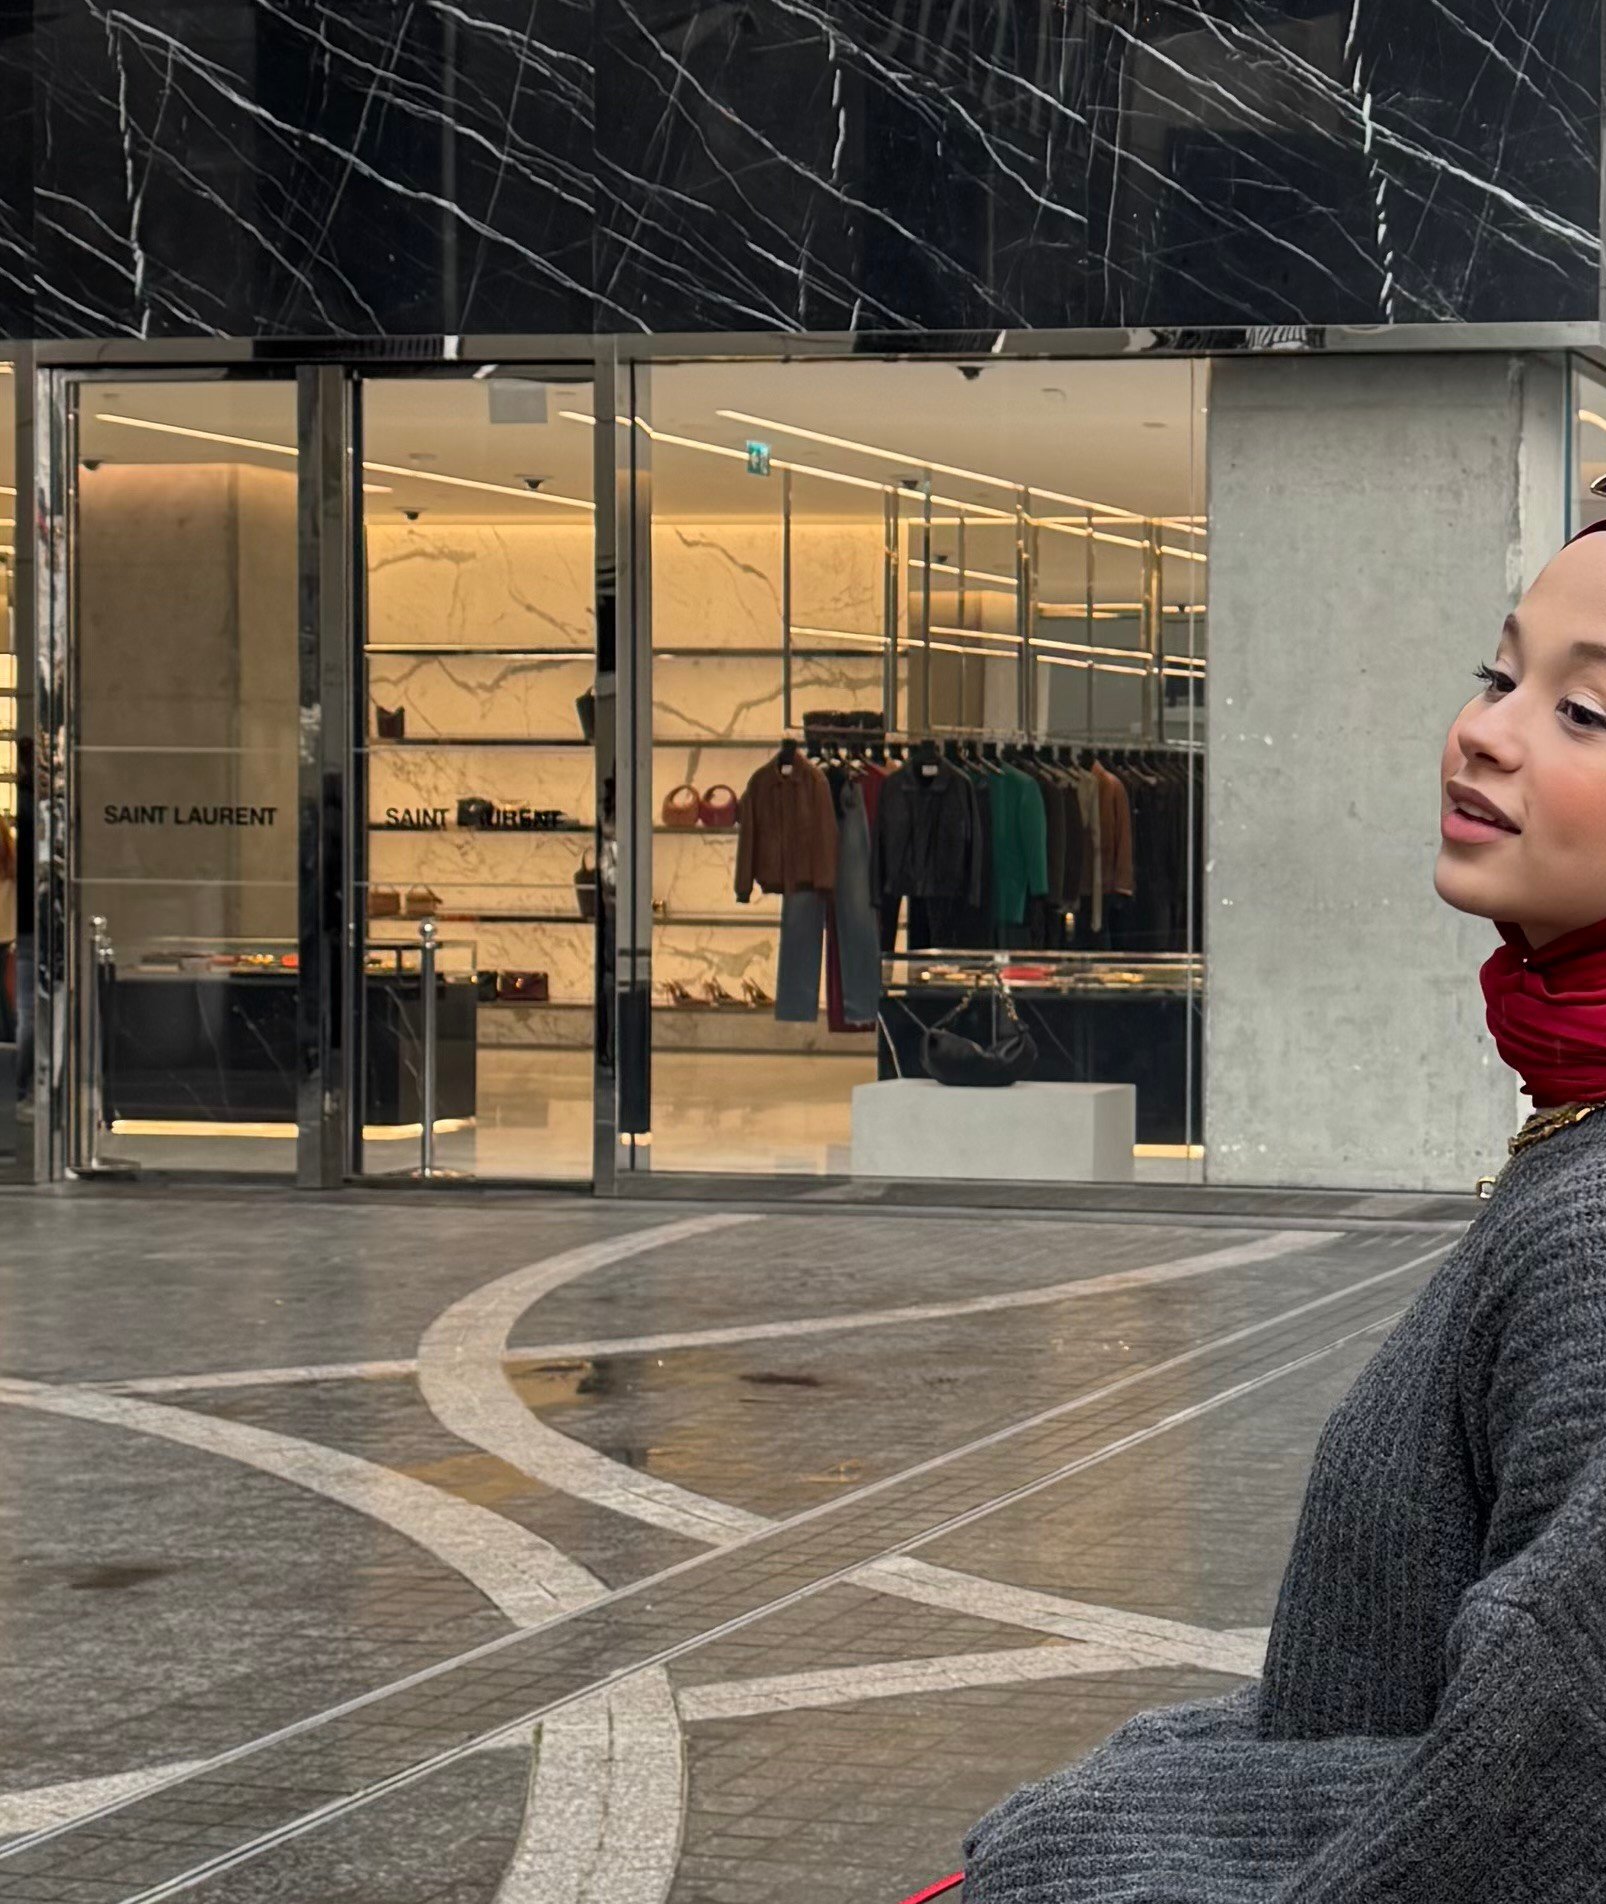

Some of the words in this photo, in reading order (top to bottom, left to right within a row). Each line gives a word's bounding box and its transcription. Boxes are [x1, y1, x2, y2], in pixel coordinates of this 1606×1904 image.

[104, 805, 168, 825] SAINT
[174, 806, 277, 826] LAURENT
[385, 807, 450, 828] SAINT
